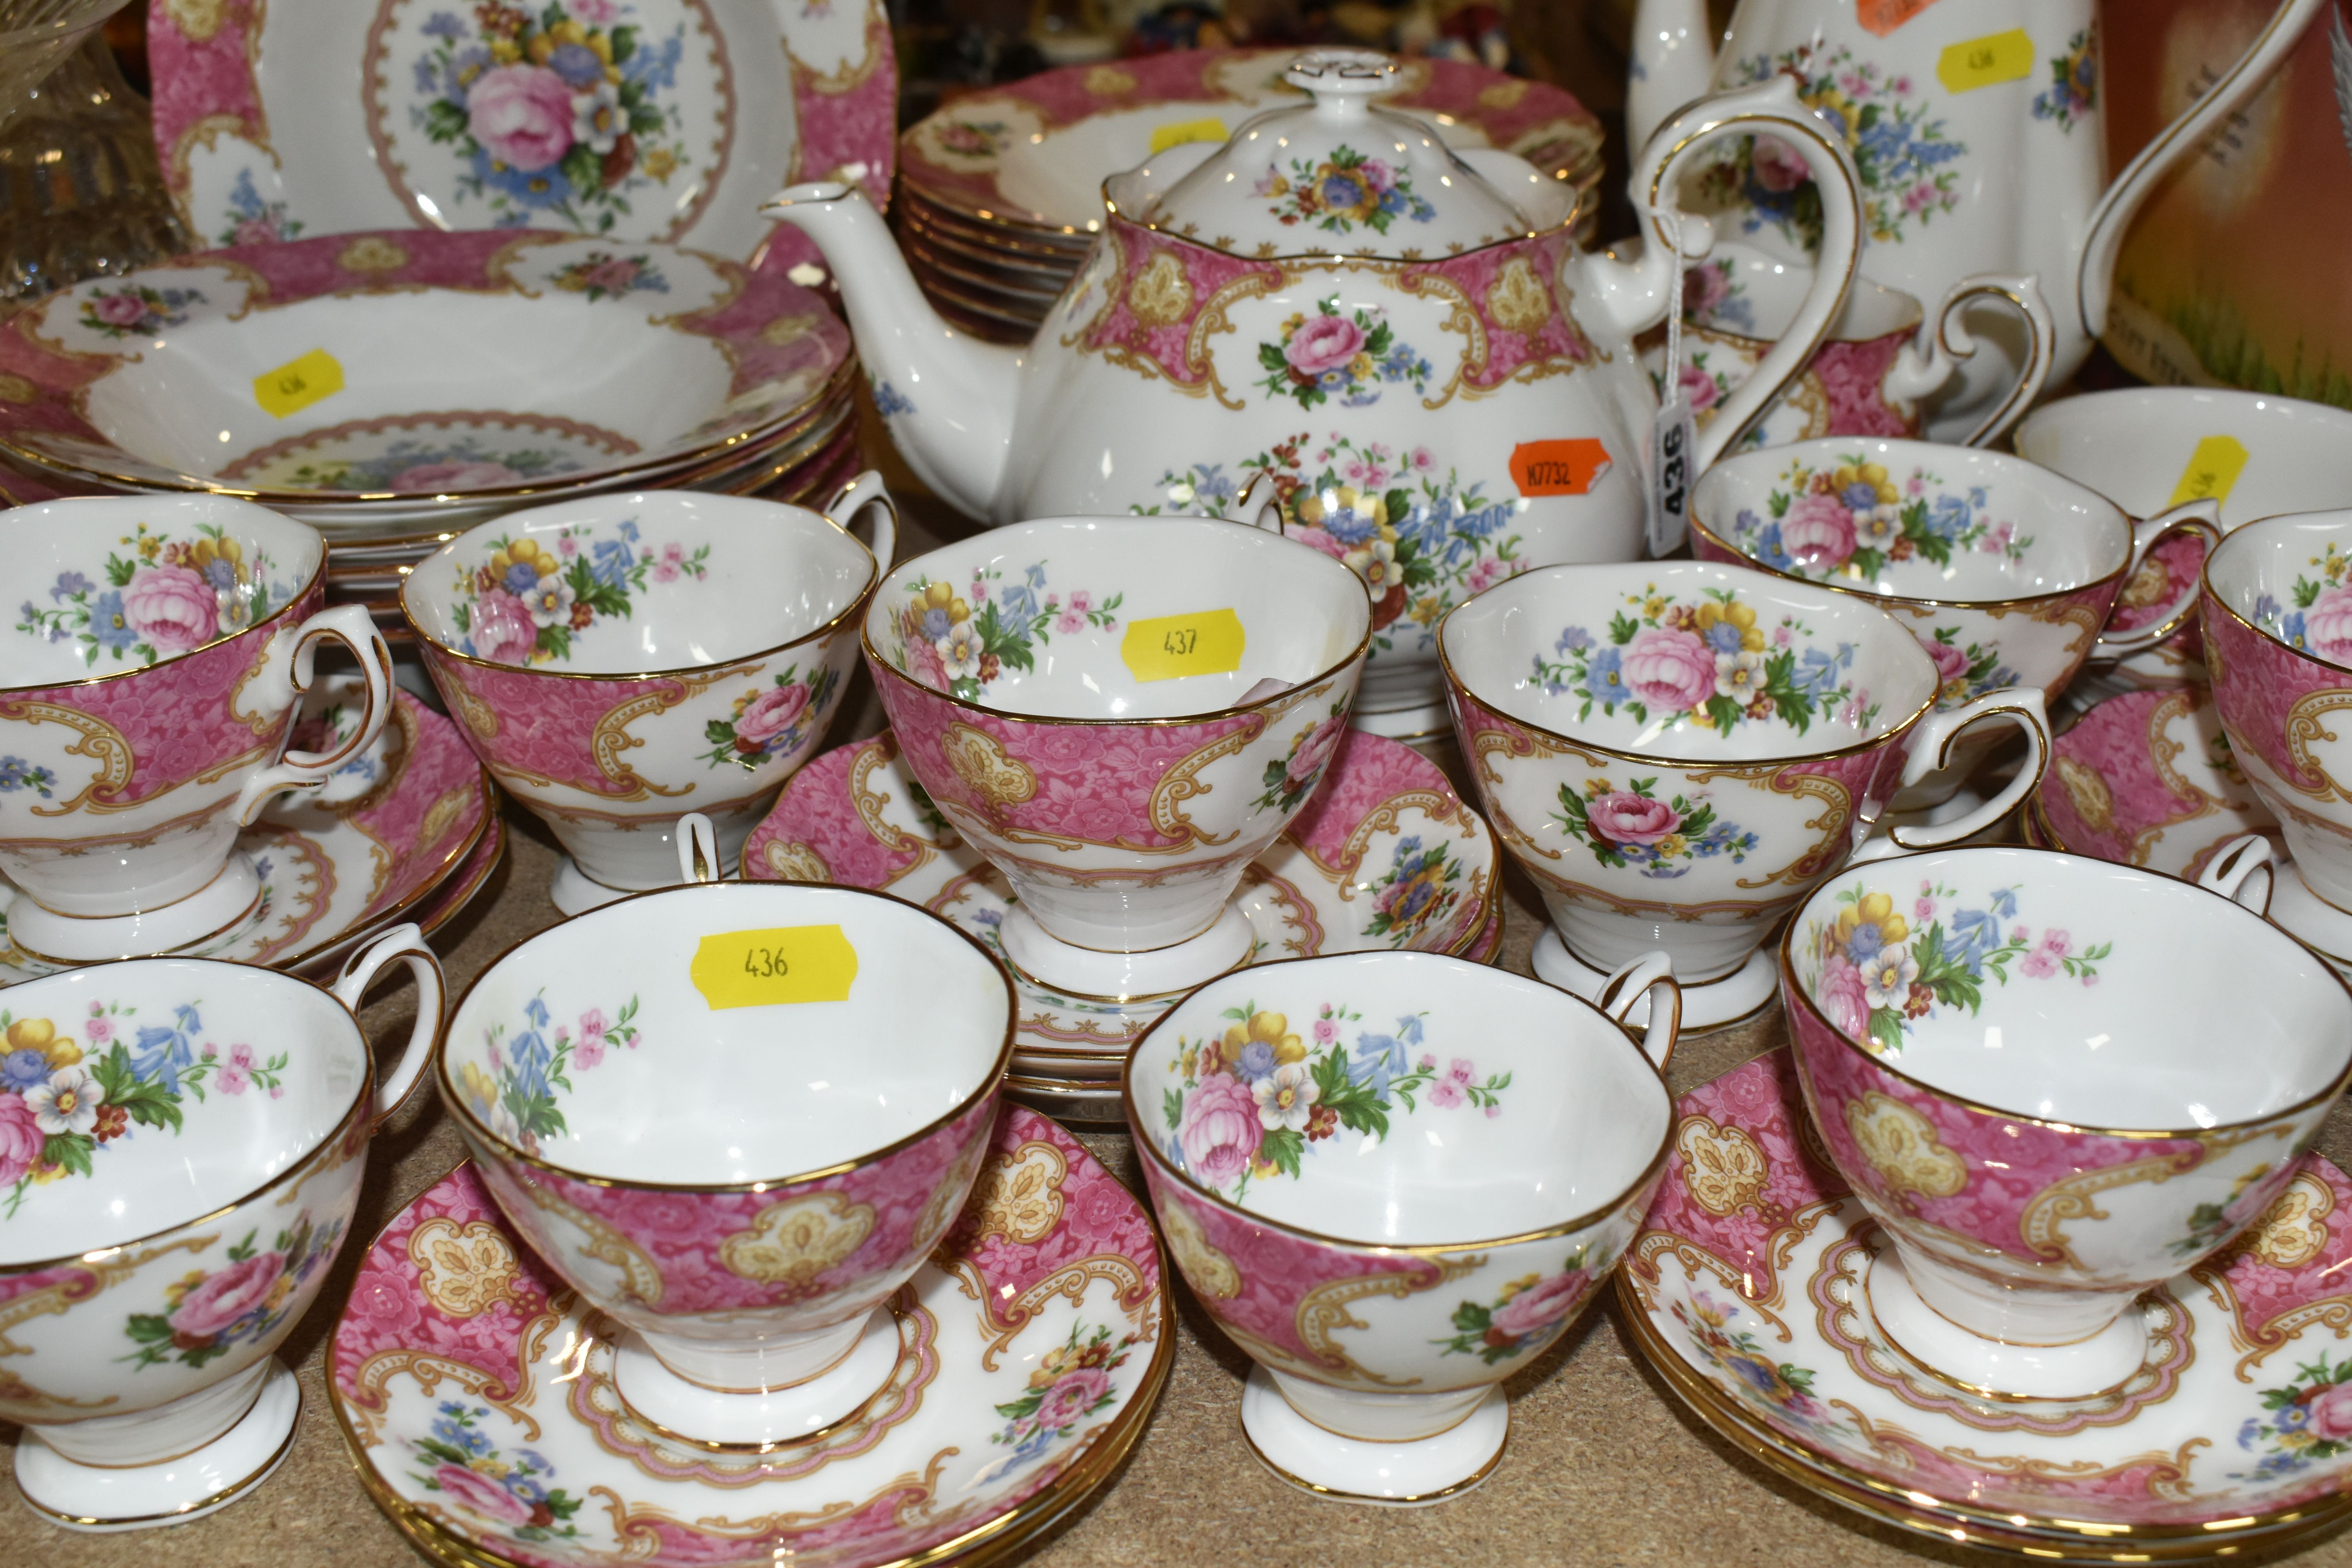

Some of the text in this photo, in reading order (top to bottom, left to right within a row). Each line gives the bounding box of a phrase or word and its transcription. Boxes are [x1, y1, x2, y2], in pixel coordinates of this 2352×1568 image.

[1663, 423, 1684, 516] 436
[1164, 628, 1197, 655] 437
[745, 947, 788, 977] 436
